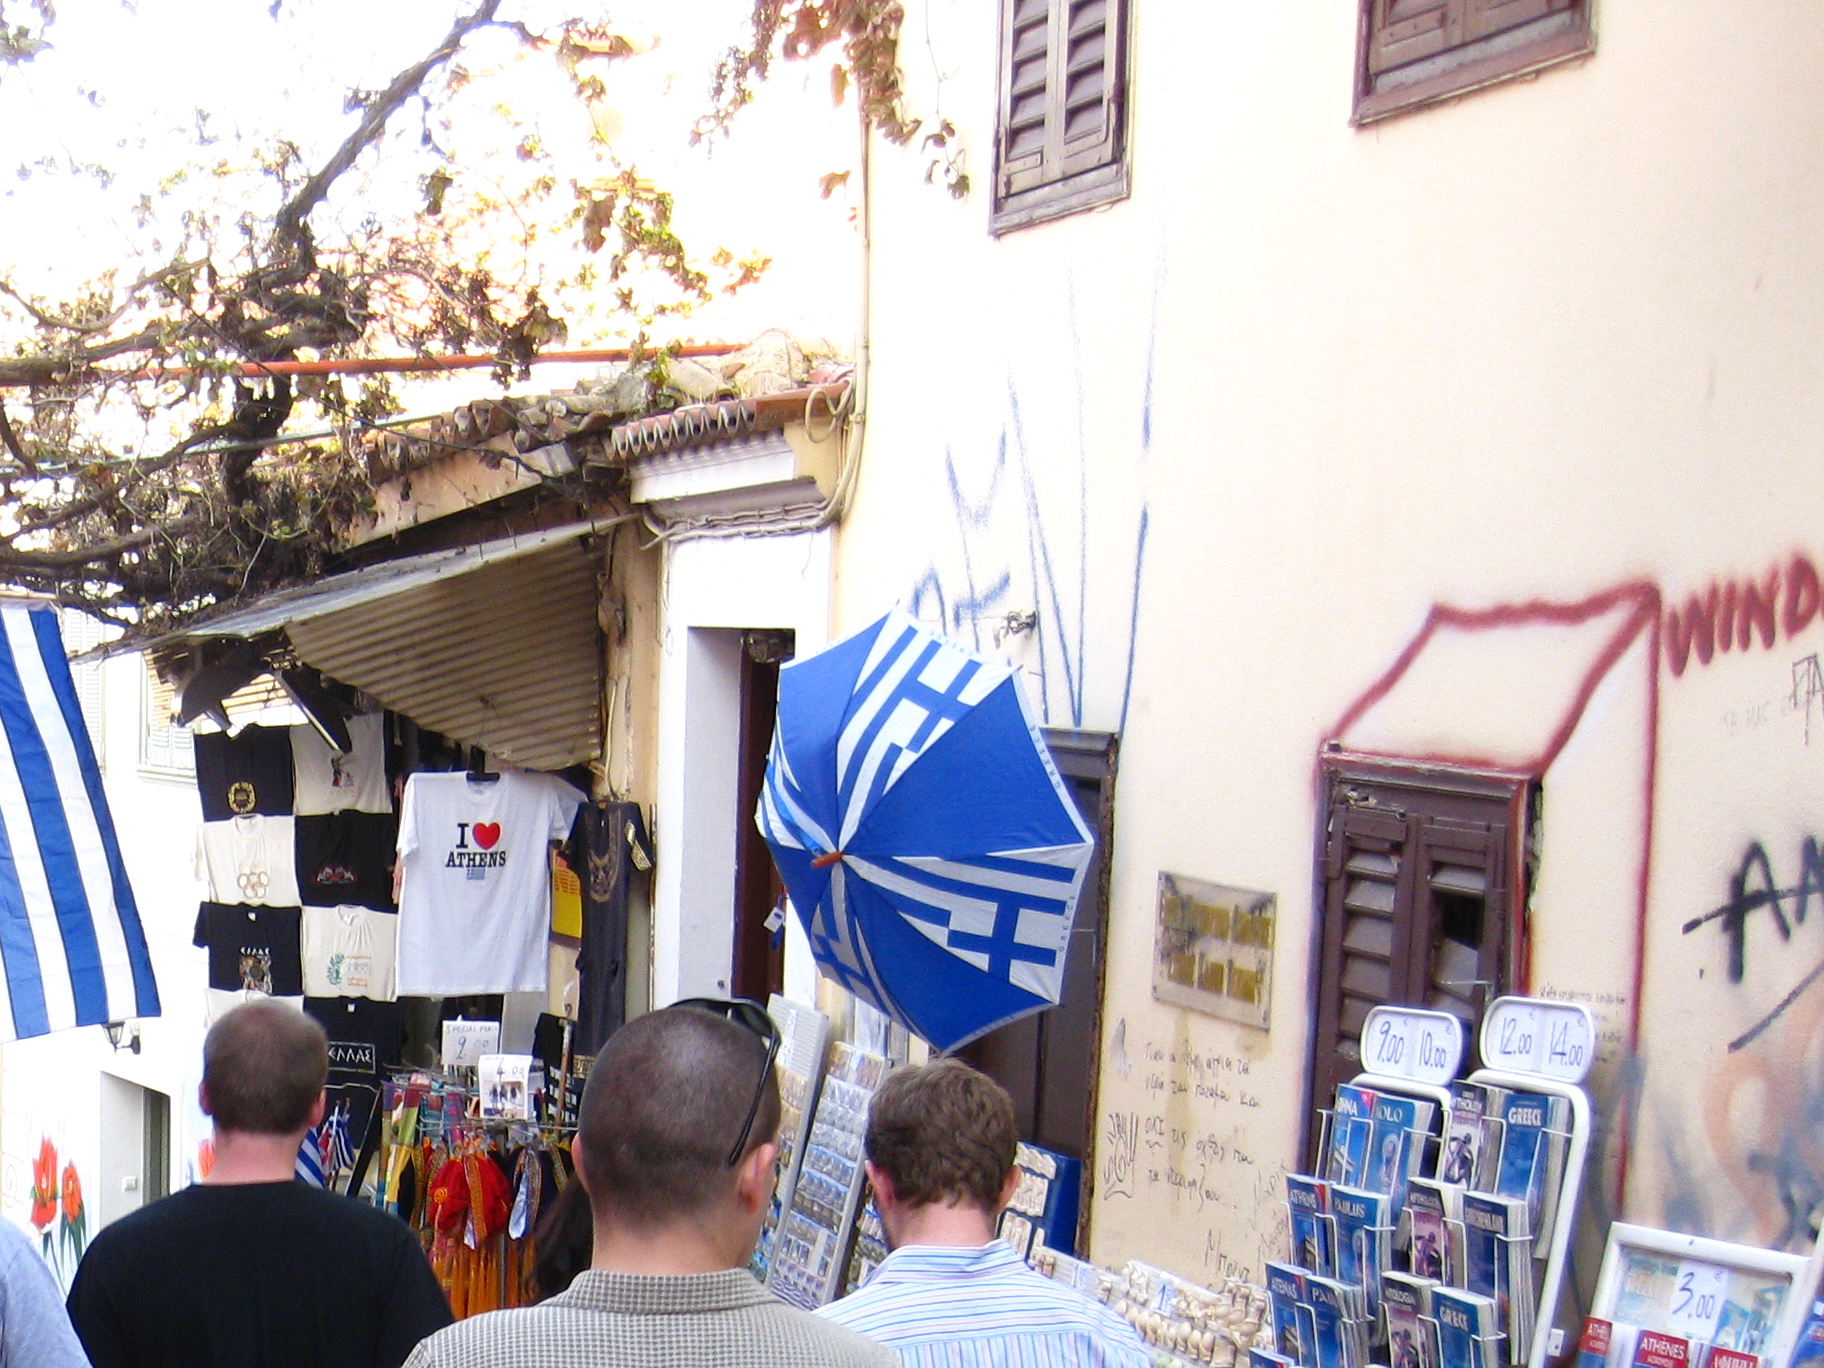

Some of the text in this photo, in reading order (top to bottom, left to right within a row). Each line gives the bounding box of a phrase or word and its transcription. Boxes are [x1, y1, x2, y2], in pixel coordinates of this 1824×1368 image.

[1664, 554, 1824, 679] WIND
[455, 822, 470, 849] I
[444, 849, 508, 869] ATHENS
[1376, 1019, 1406, 1066] 9.00
[1418, 1028, 1447, 1070] 10.00
[1498, 1017, 1534, 1057] 12.00
[1548, 1020, 1584, 1067] 14.00
[1507, 1105, 1544, 1127] GREECE
[1671, 1271, 1717, 1321] 3.00
